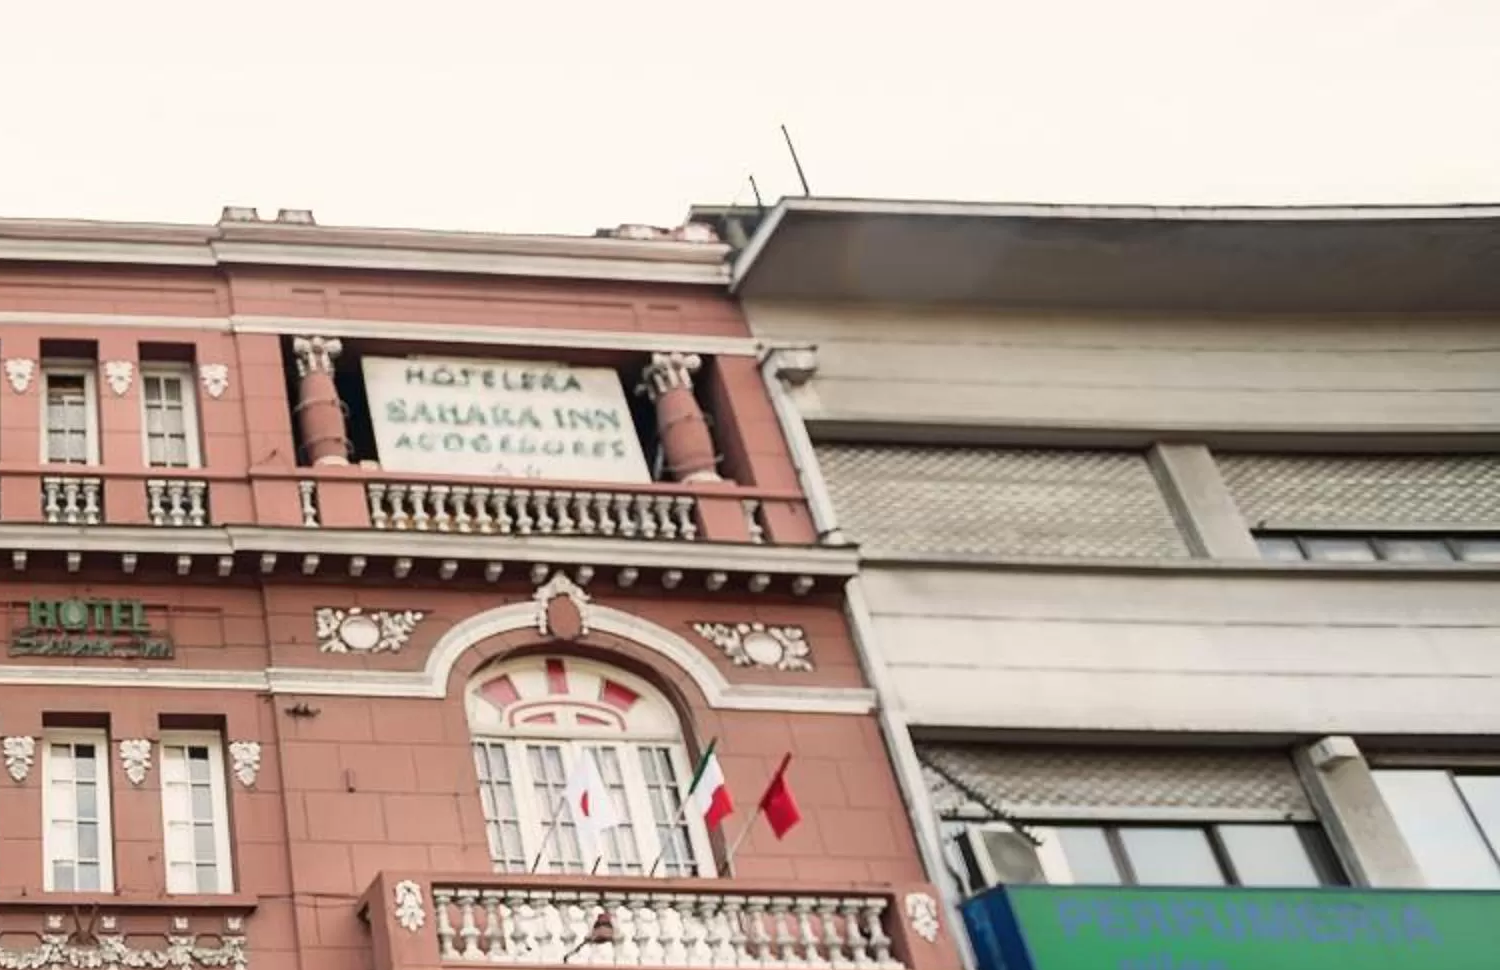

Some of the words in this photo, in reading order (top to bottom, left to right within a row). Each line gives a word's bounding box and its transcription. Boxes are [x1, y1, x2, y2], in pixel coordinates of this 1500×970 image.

[404, 367, 582, 392] HOTELERA
[386, 399, 541, 429] SAHARA
[553, 406, 621, 430] INN
[29, 598, 152, 630] HOTEL
